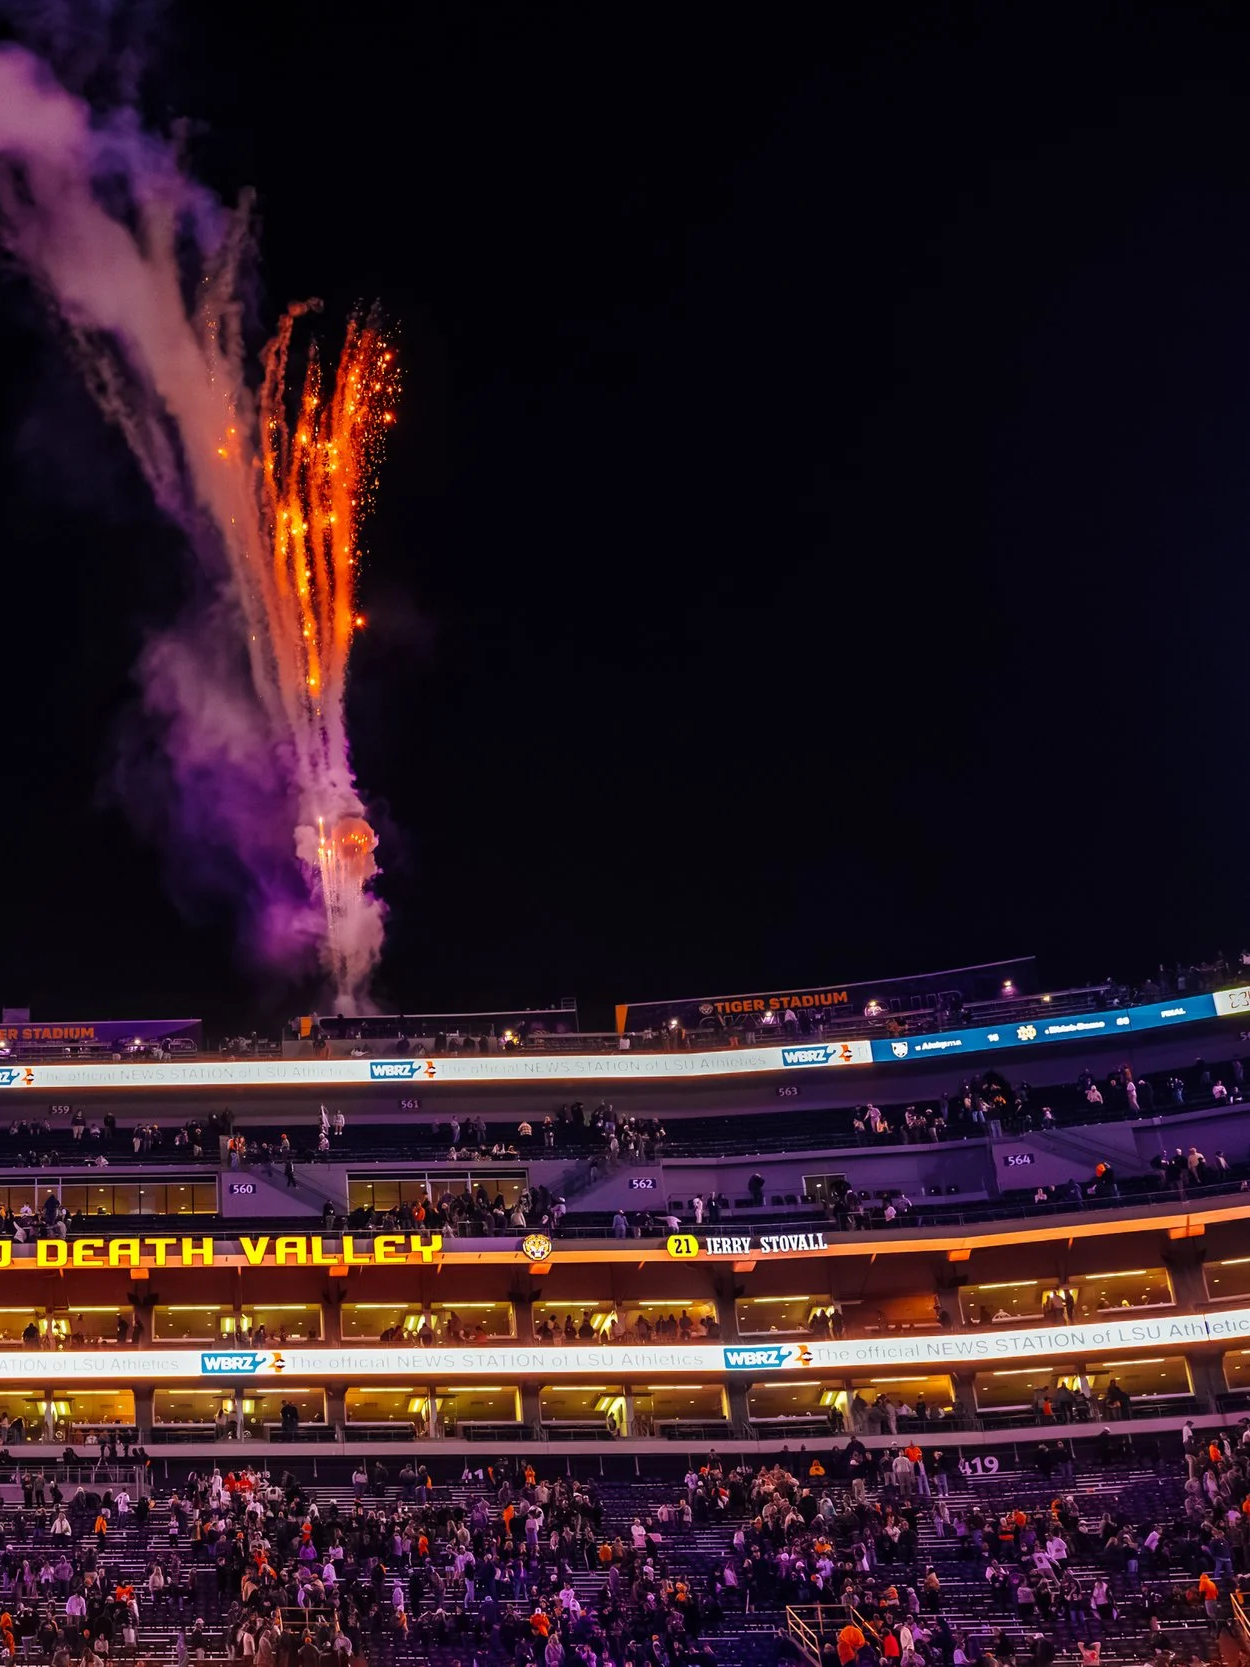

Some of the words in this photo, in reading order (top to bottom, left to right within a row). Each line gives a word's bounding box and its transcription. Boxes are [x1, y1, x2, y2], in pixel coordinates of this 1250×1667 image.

[714, 999, 766, 1014] TIGER
[769, 991, 848, 1011] STADIUM
[22, 1027, 95, 1040] STADIUM
[784, 1049, 826, 1064] WBRZ
[121, 1069, 165, 1081] NEWS
[172, 1068, 233, 1080] STATION
[257, 1067, 286, 1079] LSU
[372, 1064, 412, 1077] WBRZ
[525, 1062, 570, 1074] NEWS
[575, 1060, 640, 1073] STATION
[664, 1059, 695, 1071] LSU
[778, 1086, 799, 1097] 563
[51, 1105, 70, 1114] 559
[401, 1099, 419, 1109] 561
[1008, 1155, 1031, 1166] 564
[233, 1184, 253, 1194] 560
[632, 1179, 653, 1189] 562
[675, 1237, 691, 1254] 21
[705, 1236, 751, 1255] JERRY
[760, 1232, 828, 1254] STOVALL
[36, 1236, 214, 1269] DEATH
[239, 1233, 444, 1266] VALLEY
[726, 1350, 779, 1366] WBRZ
[816, 1347, 850, 1361] The
[855, 1344, 920, 1360] official
[925, 1340, 988, 1357] NEWS
[995, 1331, 1086, 1354] STATION
[1092, 1329, 1112, 1345] of
[1118, 1324, 1162, 1343] LSU
[73, 1358, 105, 1372] LSU
[111, 1356, 180, 1371] Athletics
[203, 1356, 254, 1371] WBRZ
[289, 1355, 322, 1369] The
[328, 1354, 391, 1369] official
[396, 1354, 455, 1368] NEWS
[462, 1354, 545, 1368] STATION
[551, 1353, 569, 1367] of
[576, 1353, 614, 1367] LSU
[621, 1351, 704, 1366] Athletics
